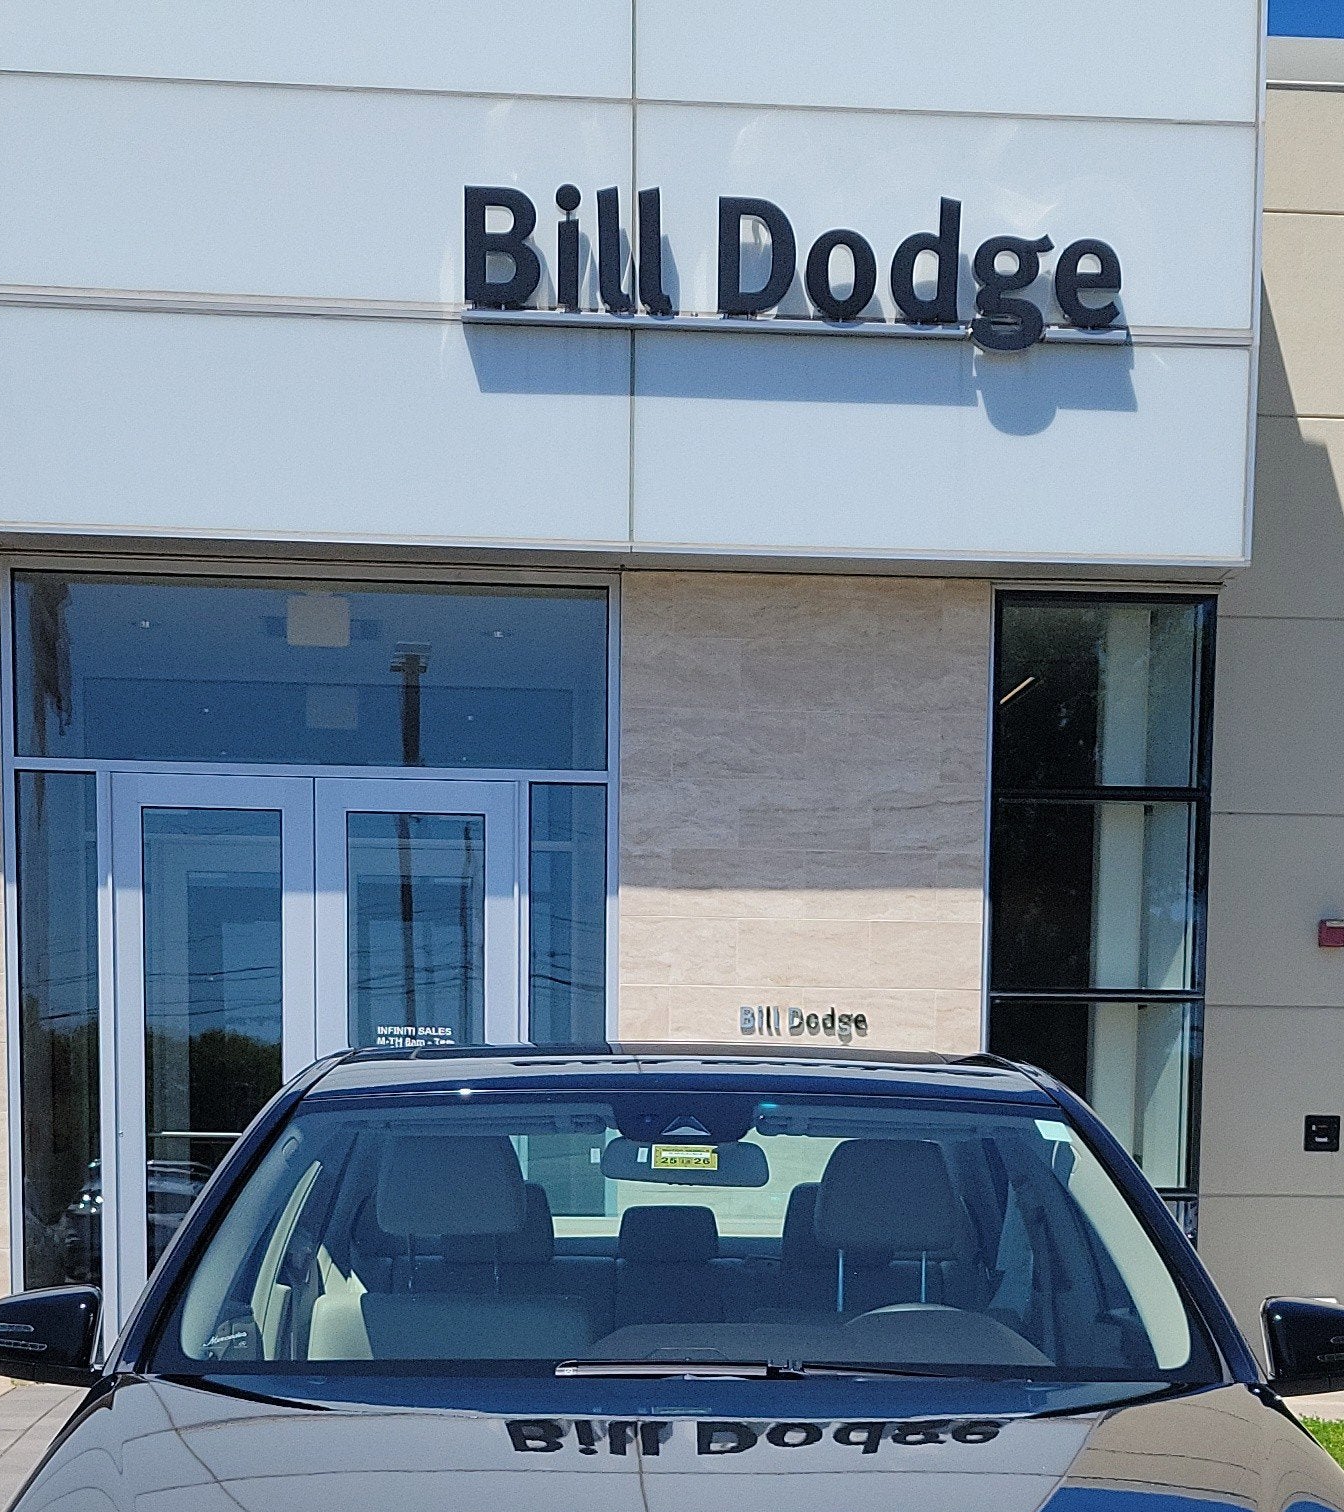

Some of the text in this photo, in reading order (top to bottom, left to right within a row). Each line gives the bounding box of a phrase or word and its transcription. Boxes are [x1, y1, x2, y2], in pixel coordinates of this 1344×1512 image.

[463, 183, 1123, 352] Bill Dodge
[377, 1026, 452, 1036] INFINITI SALES
[740, 1006, 868, 1039] Bill Dodge
